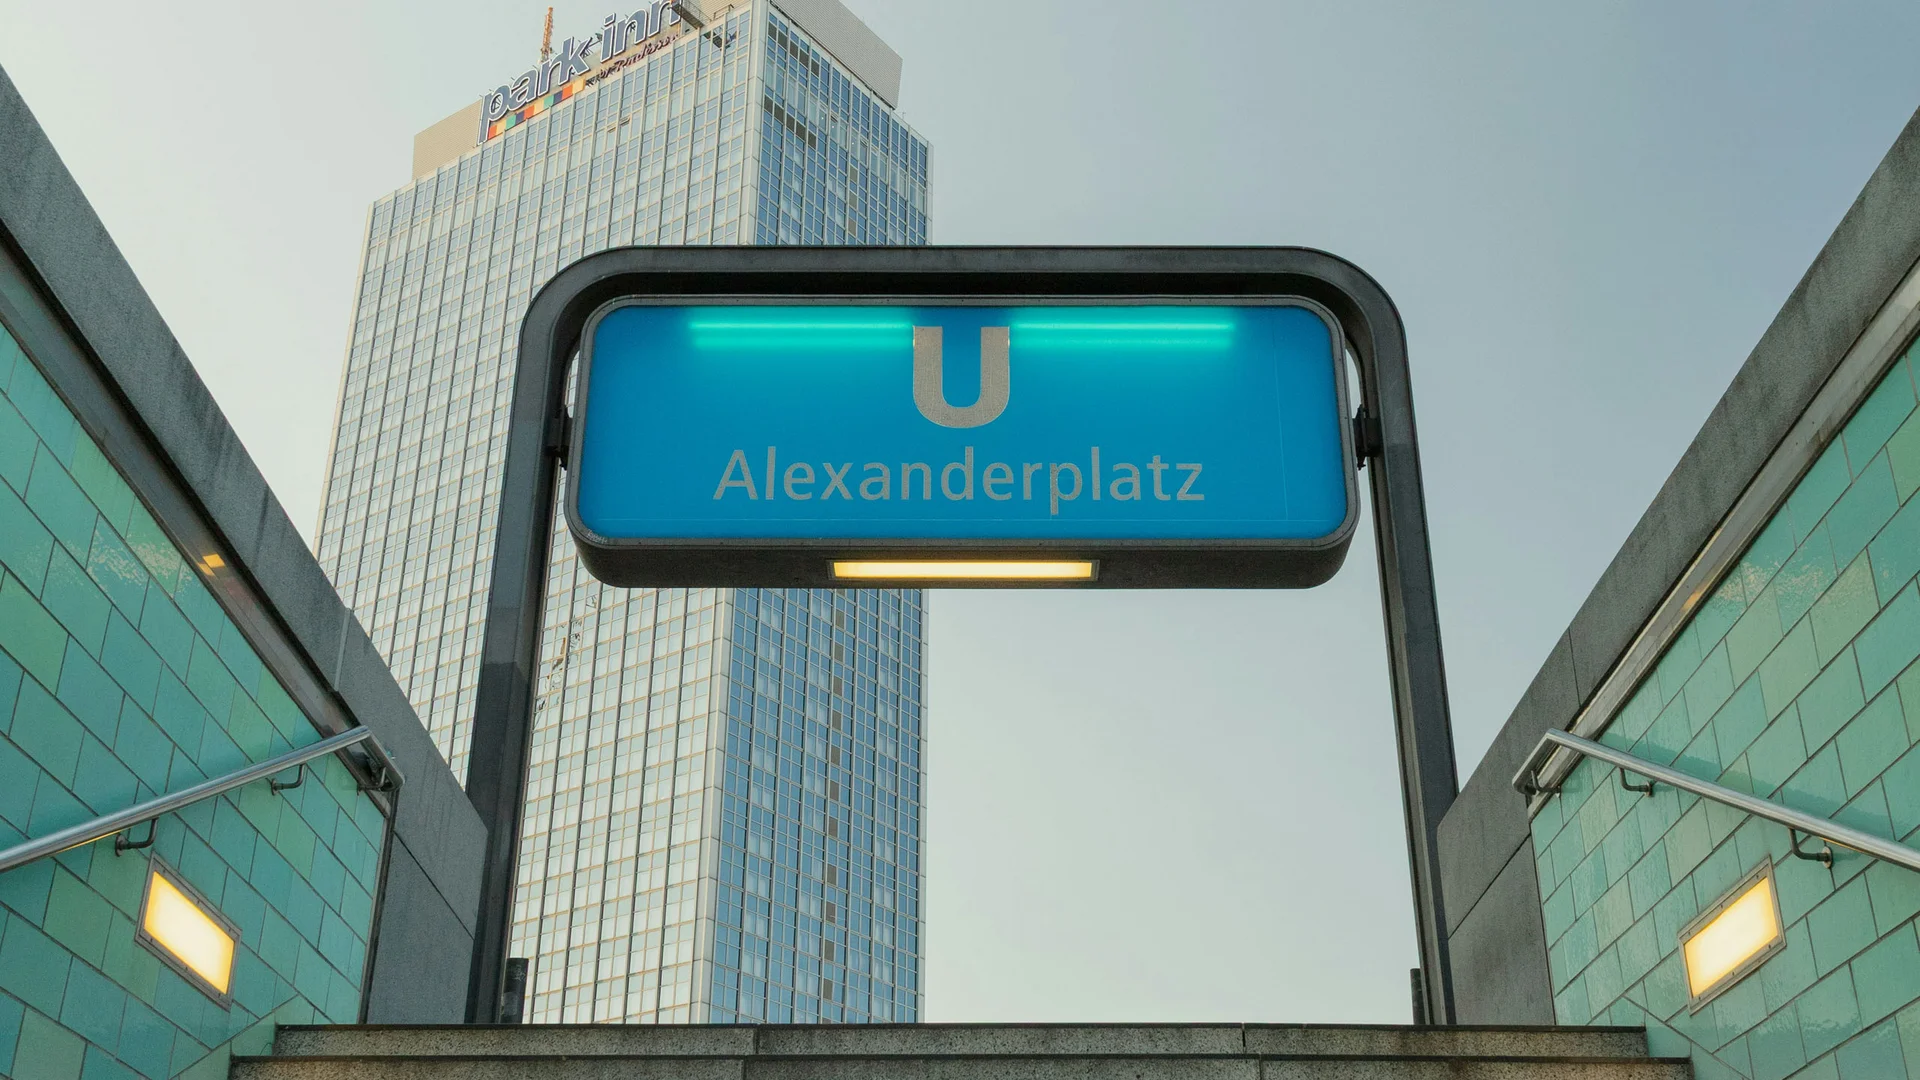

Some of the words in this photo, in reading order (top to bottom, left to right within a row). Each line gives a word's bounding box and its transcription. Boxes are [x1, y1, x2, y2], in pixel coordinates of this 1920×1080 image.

[477, 36, 592, 145] park
[600, 0, 681, 63] inn
[912, 325, 1010, 429] U
[712, 446, 1205, 516] Alexanderplatz
